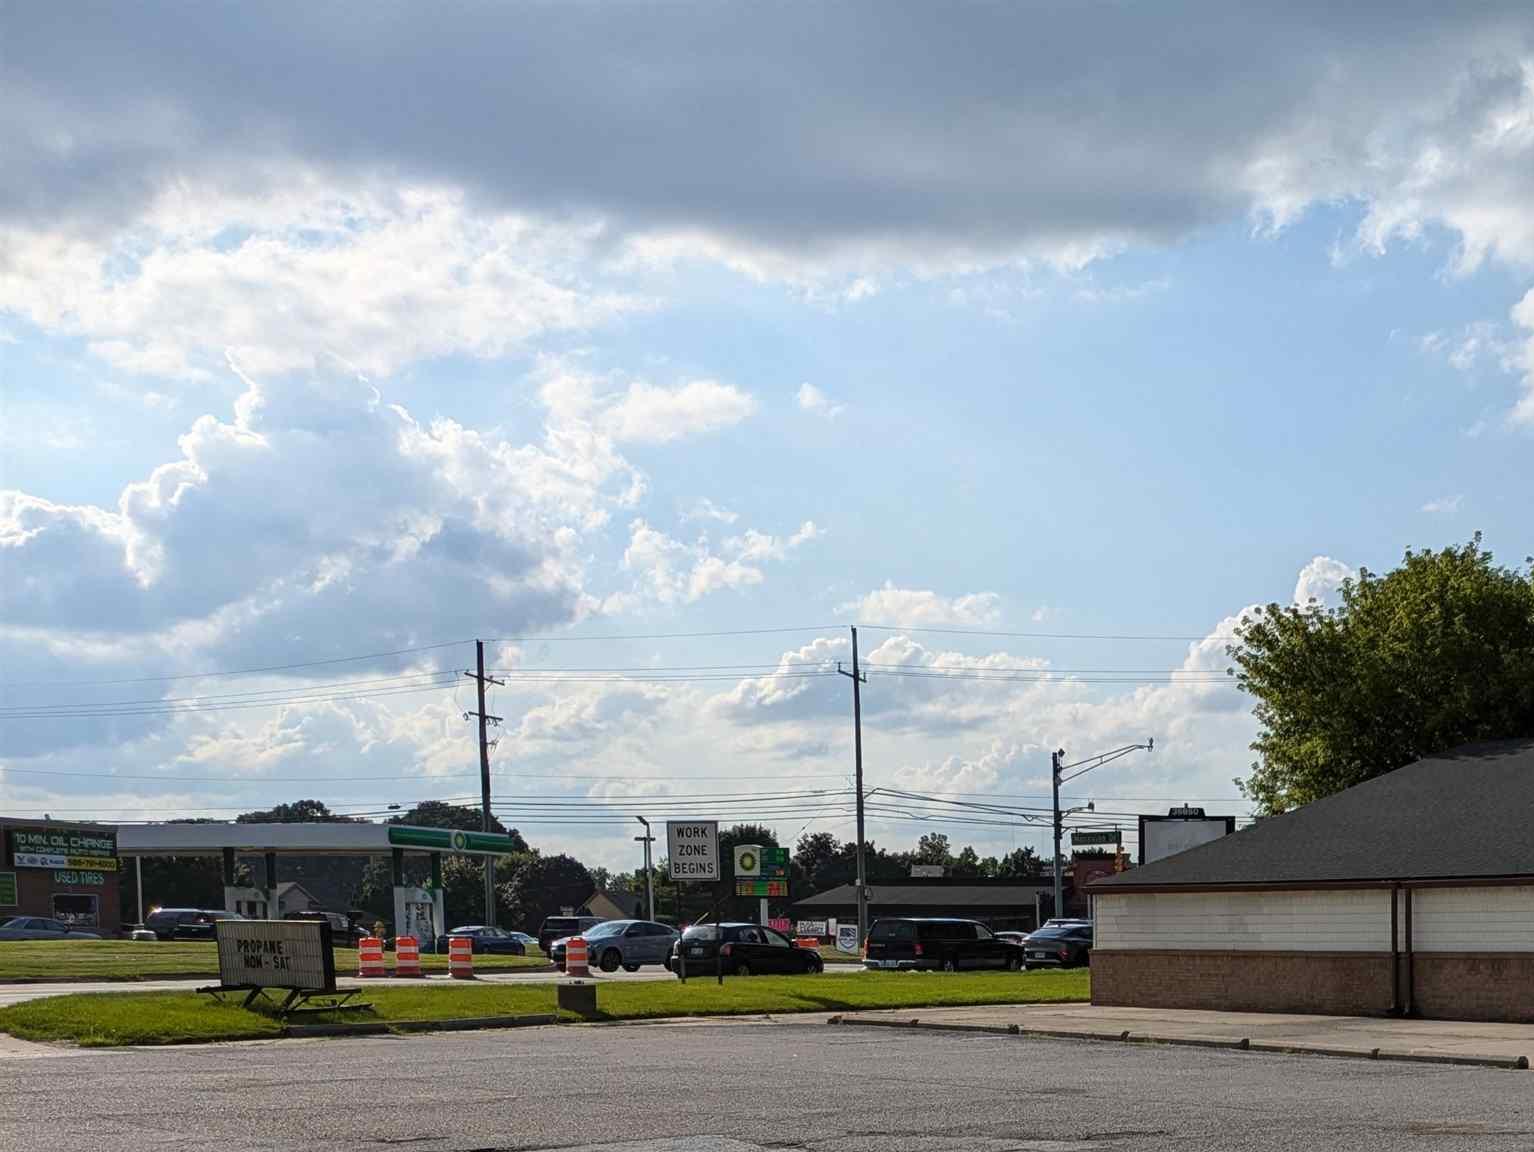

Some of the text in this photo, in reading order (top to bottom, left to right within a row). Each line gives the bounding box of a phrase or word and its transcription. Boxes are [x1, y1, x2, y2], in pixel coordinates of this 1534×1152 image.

[676, 826, 708, 838] WORK
[50, 836, 69, 848] OIL
[70, 837, 114, 849] CHANGE
[678, 844, 708, 857] ZONE
[673, 862, 714, 875] BEGINS
[54, 871, 105, 885] USED TIRES
[237, 940, 283, 954] PROPANE
[273, 955, 291, 970] SAT
